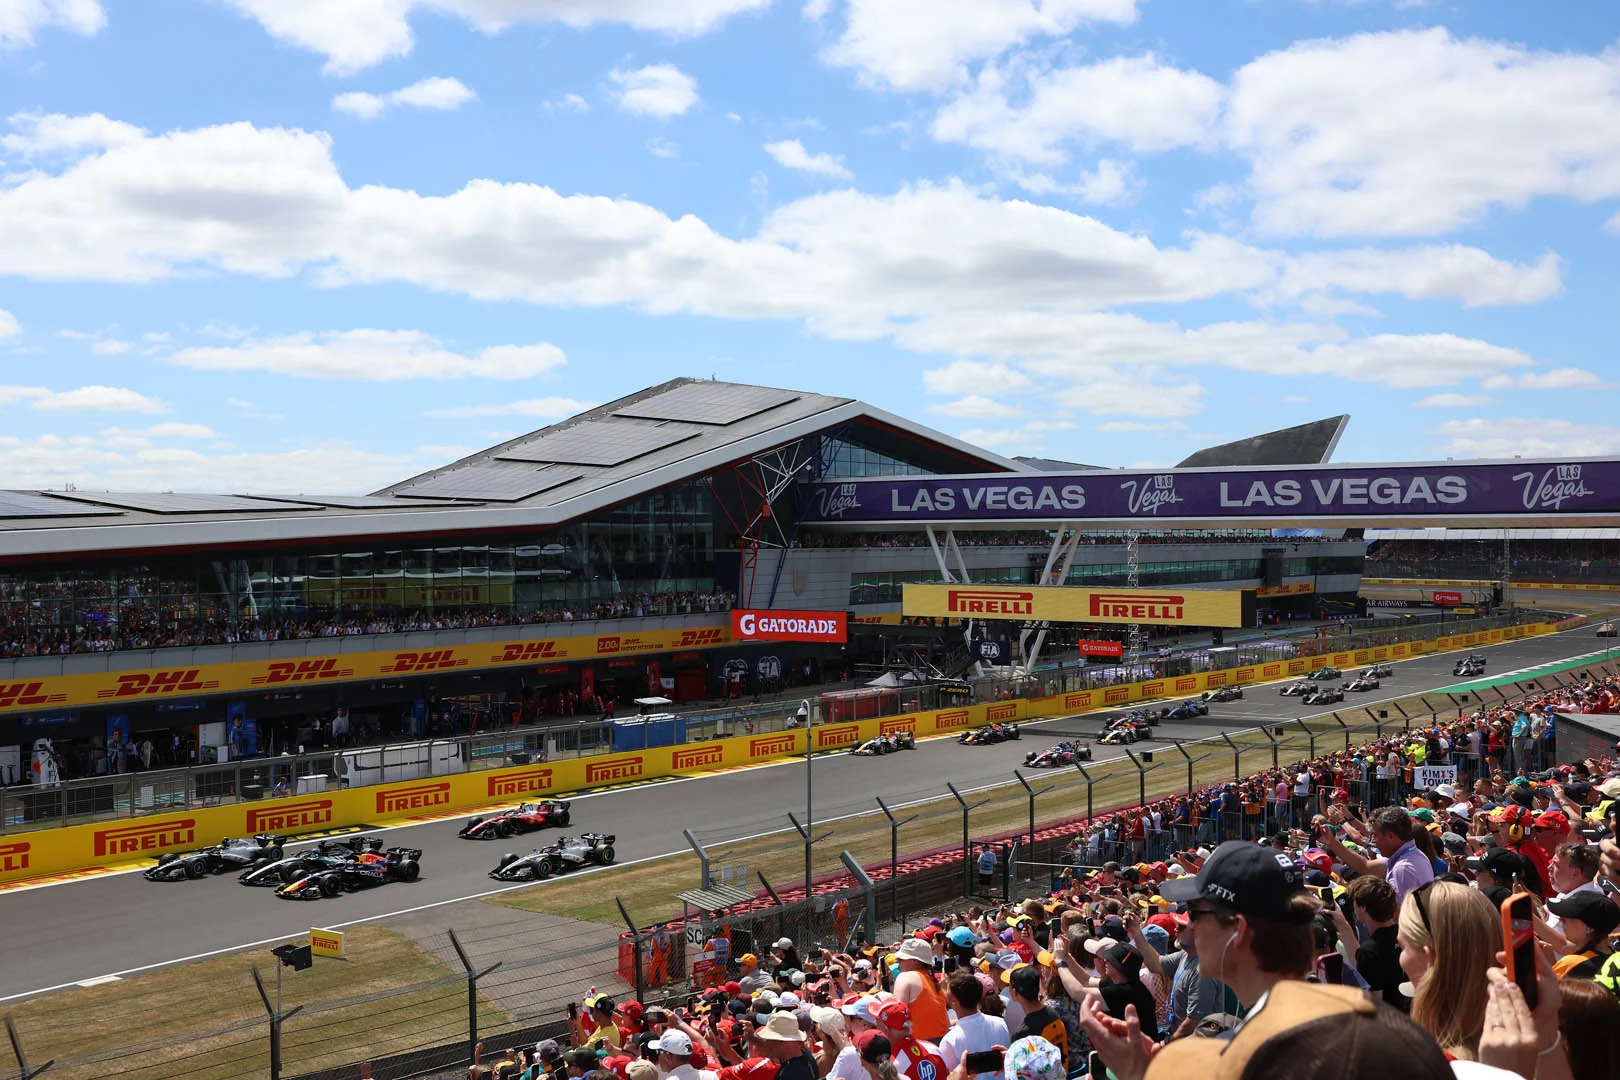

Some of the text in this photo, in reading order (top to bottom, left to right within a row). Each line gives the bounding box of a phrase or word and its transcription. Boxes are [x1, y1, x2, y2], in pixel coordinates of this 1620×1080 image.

[1156, 476, 1172, 488] LAS
[1559, 466, 1579, 478] LAS
[892, 485, 1086, 512] LAS VEGAS
[1121, 478, 1183, 514] Vegas
[1220, 475, 1467, 507] LAS VEGAS
[1513, 469, 1594, 510] Vegas
[816, 487, 861, 518] Vegas
[948, 590, 1033, 615] PIRELLI
[1089, 593, 1185, 619] PIRELLI
[740, 614, 755, 635] G
[758, 618, 837, 634] GATORADE
[680, 629, 723, 646] DHL
[394, 650, 457, 671] DHL
[503, 641, 557, 662] DHL
[982, 644, 998, 656] FIA
[266, 659, 341, 683] DHL
[0, 682, 48, 707] HL
[116, 670, 203, 697] DHL
[1142, 681, 1164, 697] PIRELLI
[1065, 692, 1091, 710] PIRELLI
[1104, 687, 1129, 703] PIRELLI
[935, 710, 969, 729] PIRELLI
[986, 703, 1017, 723] PIRELLI
[749, 734, 796, 757] PIRELLI
[818, 725, 859, 747] PIRELLI
[672, 744, 723, 770] PIRELLI
[586, 756, 643, 783] PIRELLI
[488, 768, 553, 797] PIRELLI
[376, 782, 451, 814] PIRELLI
[246, 799, 333, 833] PIRELLI
[94, 819, 196, 856] PIRELLI
[359, 870, 384, 879] ORACLE
[1215, 887, 1236, 903] FTX
[312, 936, 339, 951] PIRELLI
[687, 926, 702, 945] SC
[919, 1061, 933, 1079] hp
